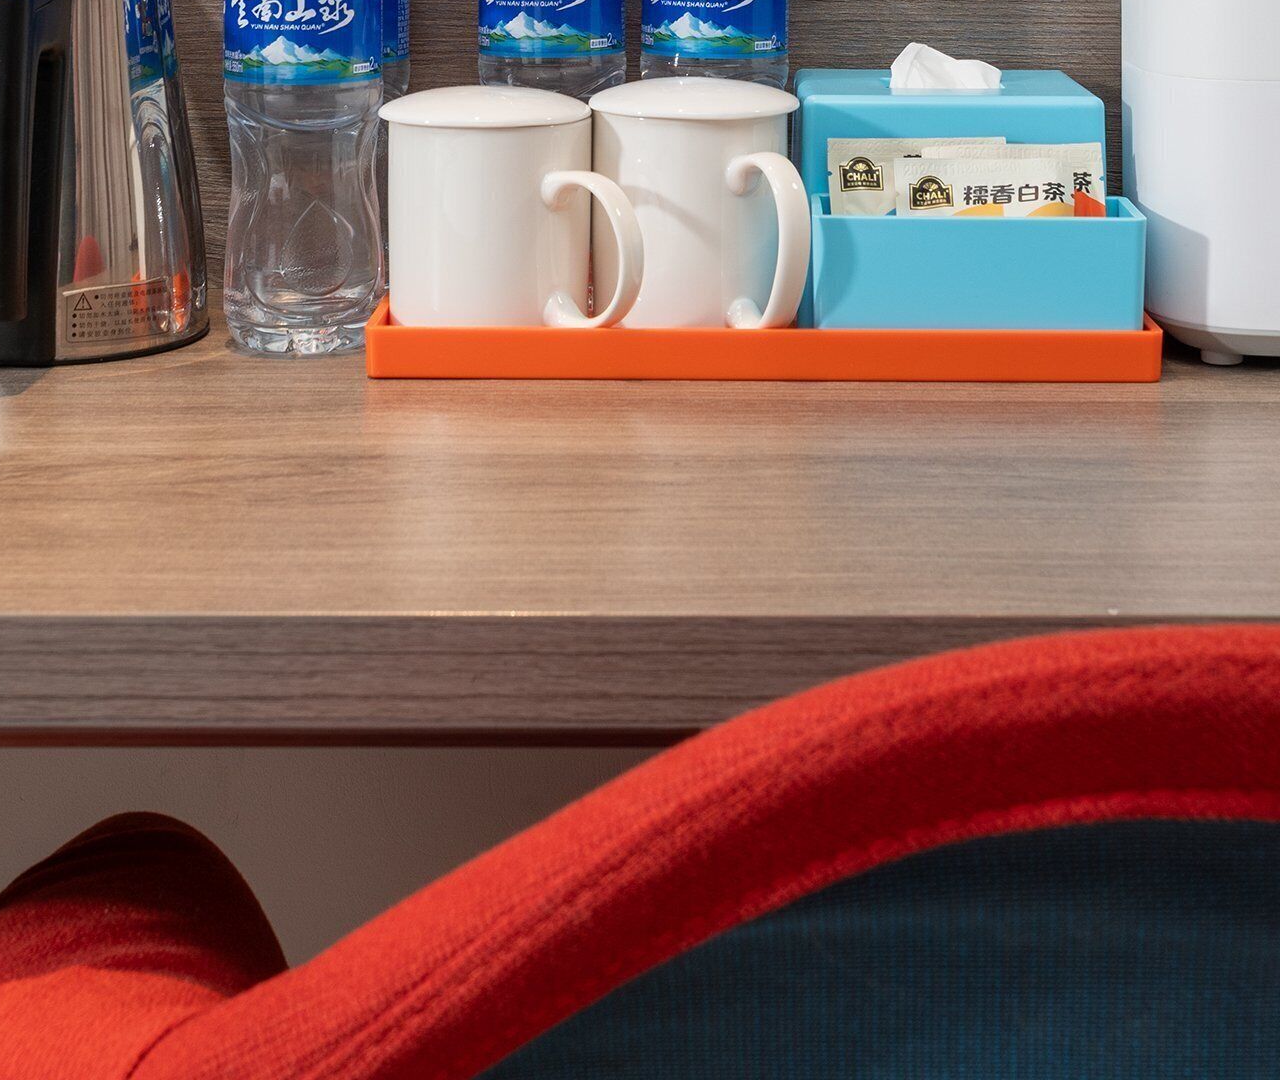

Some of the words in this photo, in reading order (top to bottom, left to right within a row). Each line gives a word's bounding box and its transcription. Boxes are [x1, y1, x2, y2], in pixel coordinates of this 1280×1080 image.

[846, 172, 878, 182] CHALI
[1072, 172, 1092, 195] 茶
[916, 191, 948, 201] CHALI
[963, 182, 1065, 206] 糯香白茶
